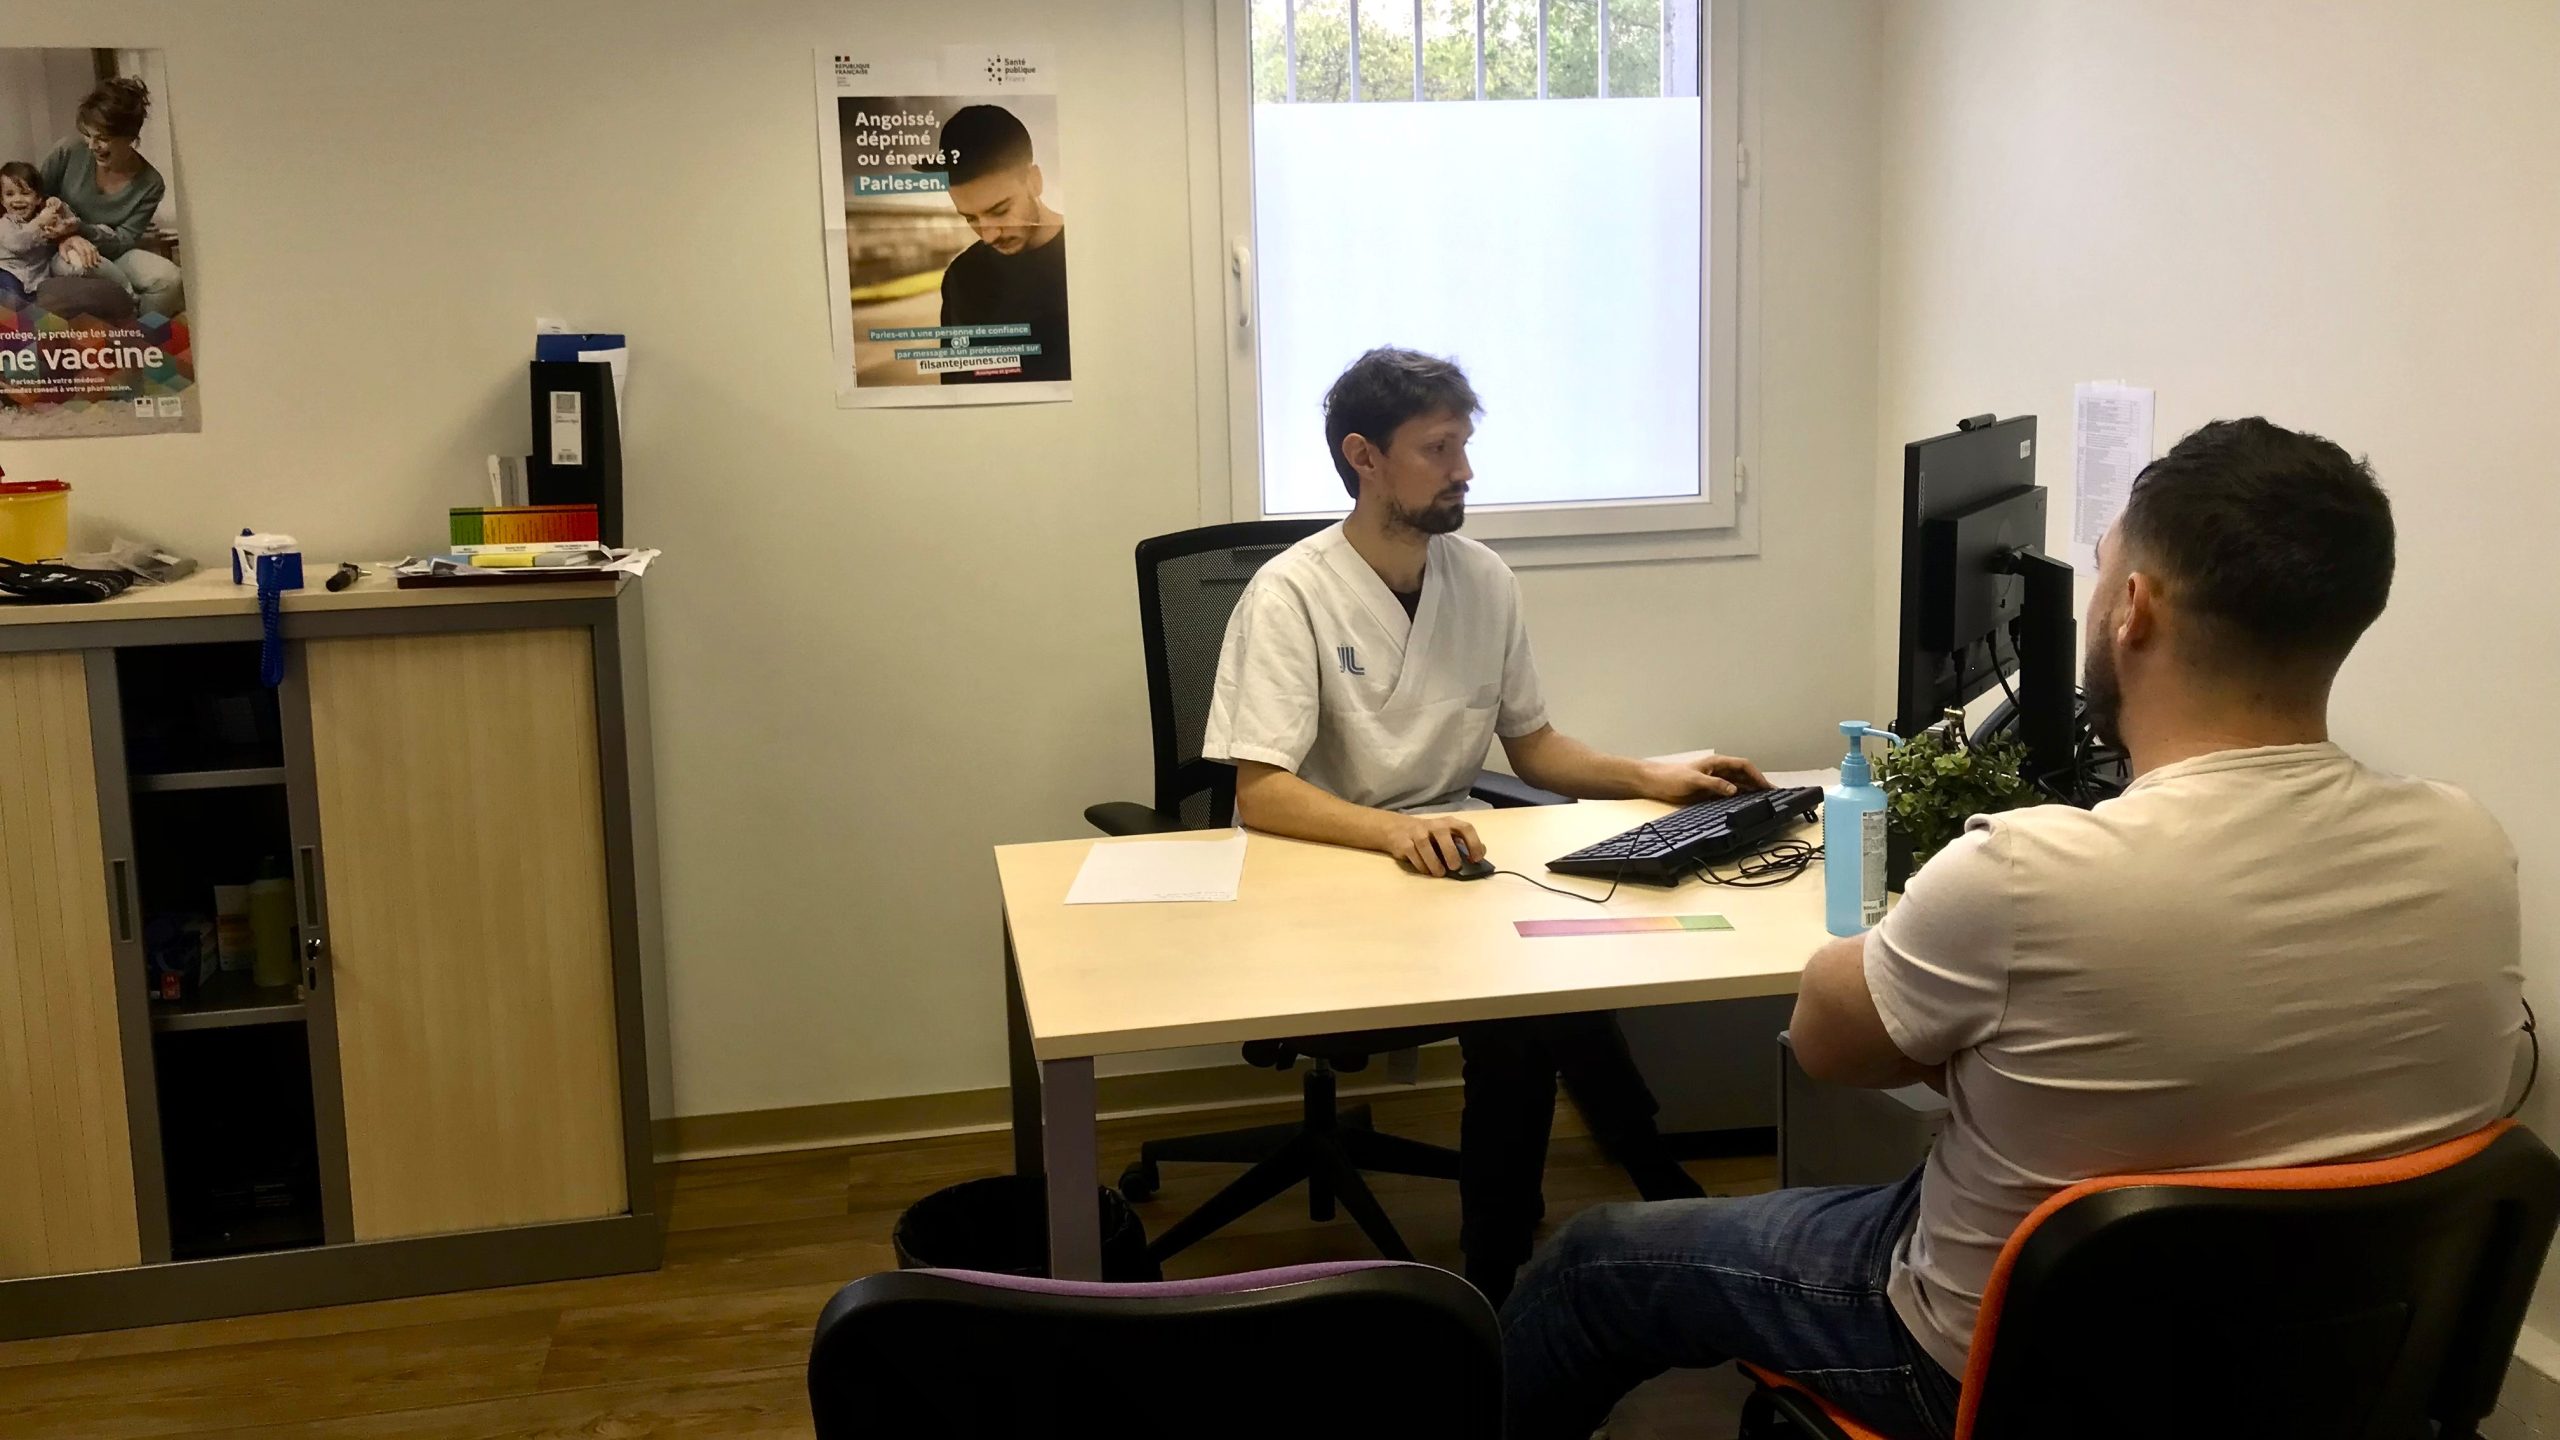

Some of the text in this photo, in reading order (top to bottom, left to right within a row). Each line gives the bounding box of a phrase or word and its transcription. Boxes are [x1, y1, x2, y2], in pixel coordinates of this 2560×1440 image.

[1004, 58, 1025, 66] Santé
[1005, 66, 1036, 74] publique
[855, 111, 940, 130] Angoissé,
[856, 131, 931, 149] déprimé
[857, 150, 961, 166] ou énervé ?
[859, 175, 946, 191] Parles-en.
[0, 329, 145, 342] rotège, je protège les autres,
[935, 329, 974, 338] personne
[975, 327, 987, 335] de
[987, 326, 1029, 335] confiance
[42, 340, 164, 370] vaccine
[896, 350, 912, 359] par
[913, 349, 947, 358] message
[969, 345, 1025, 356] professionnel
[919, 355, 1019, 370] filsantejeunes.com
